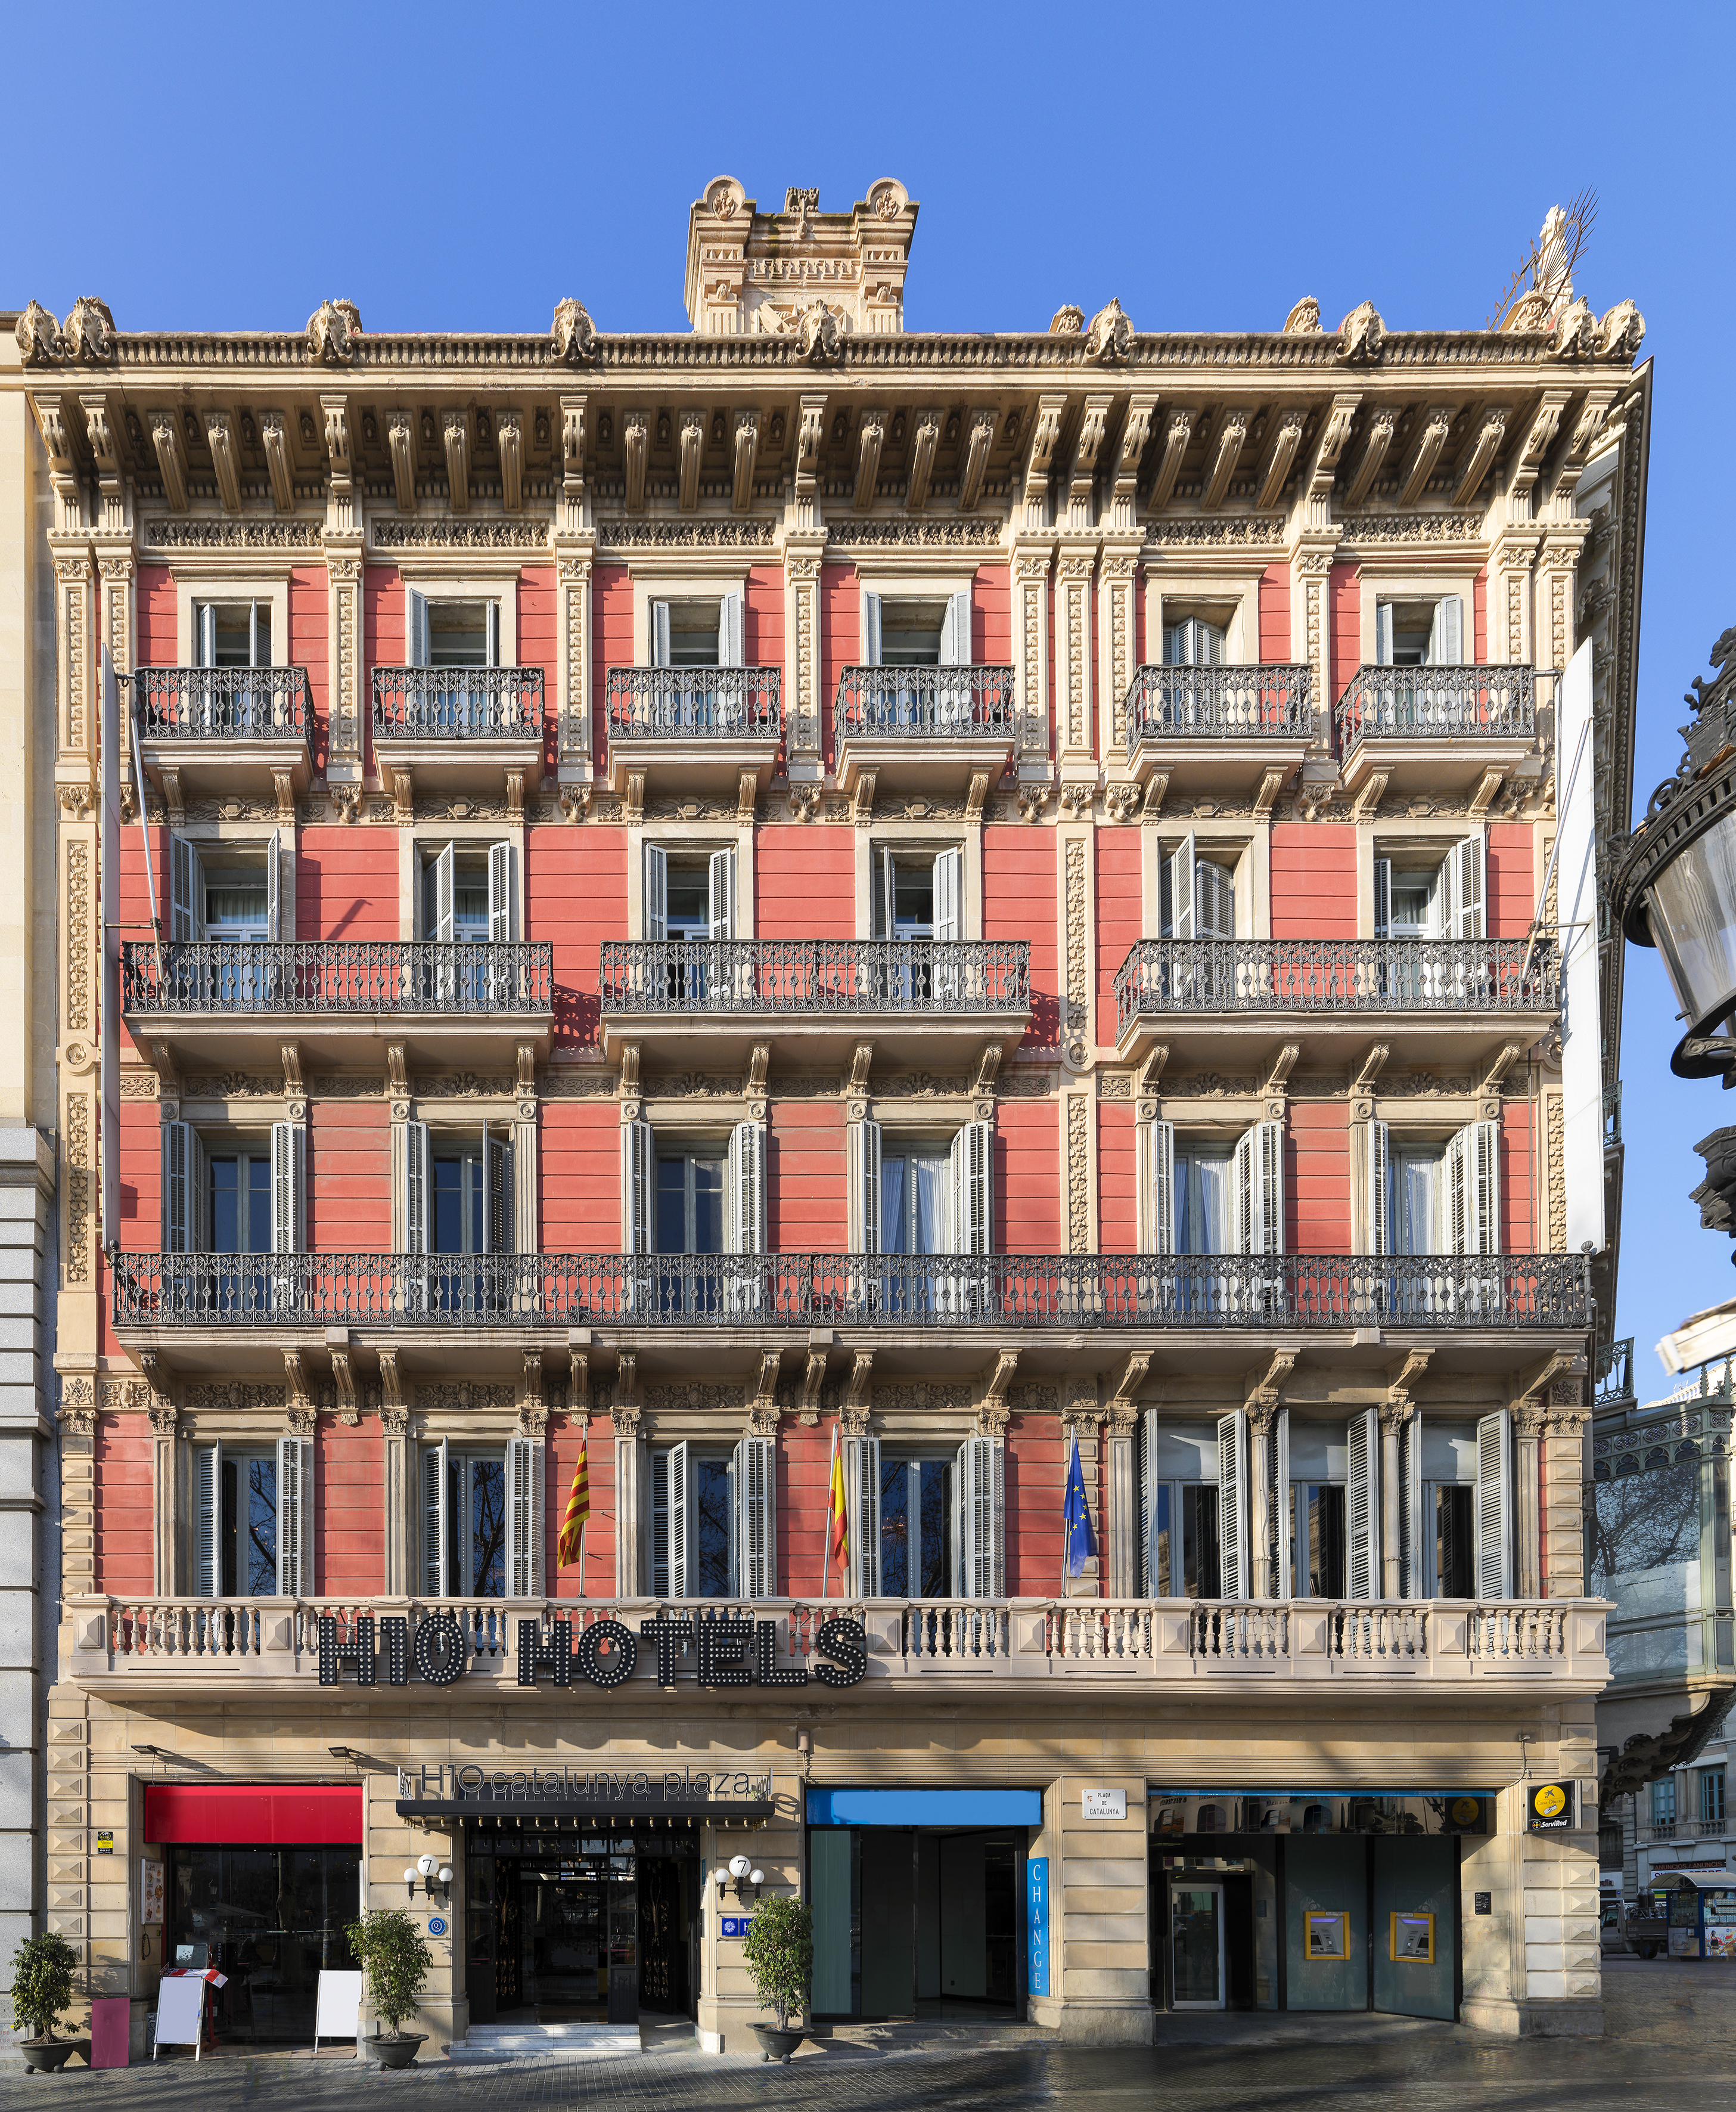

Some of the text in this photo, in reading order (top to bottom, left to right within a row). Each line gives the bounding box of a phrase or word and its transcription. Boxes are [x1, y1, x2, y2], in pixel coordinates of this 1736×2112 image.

[318, 1615, 867, 1688] H10 HOTELS
[421, 1764, 485, 1793] H10
[490, 1765, 651, 1801] catalunya
[663, 1764, 751, 1801] plaza
[1541, 1819, 1567, 1828] ServiRed
[423, 1859, 432, 1872] 7
[738, 1860, 747, 1873] 7
[1033, 1864, 1042, 1989] CHANGE
